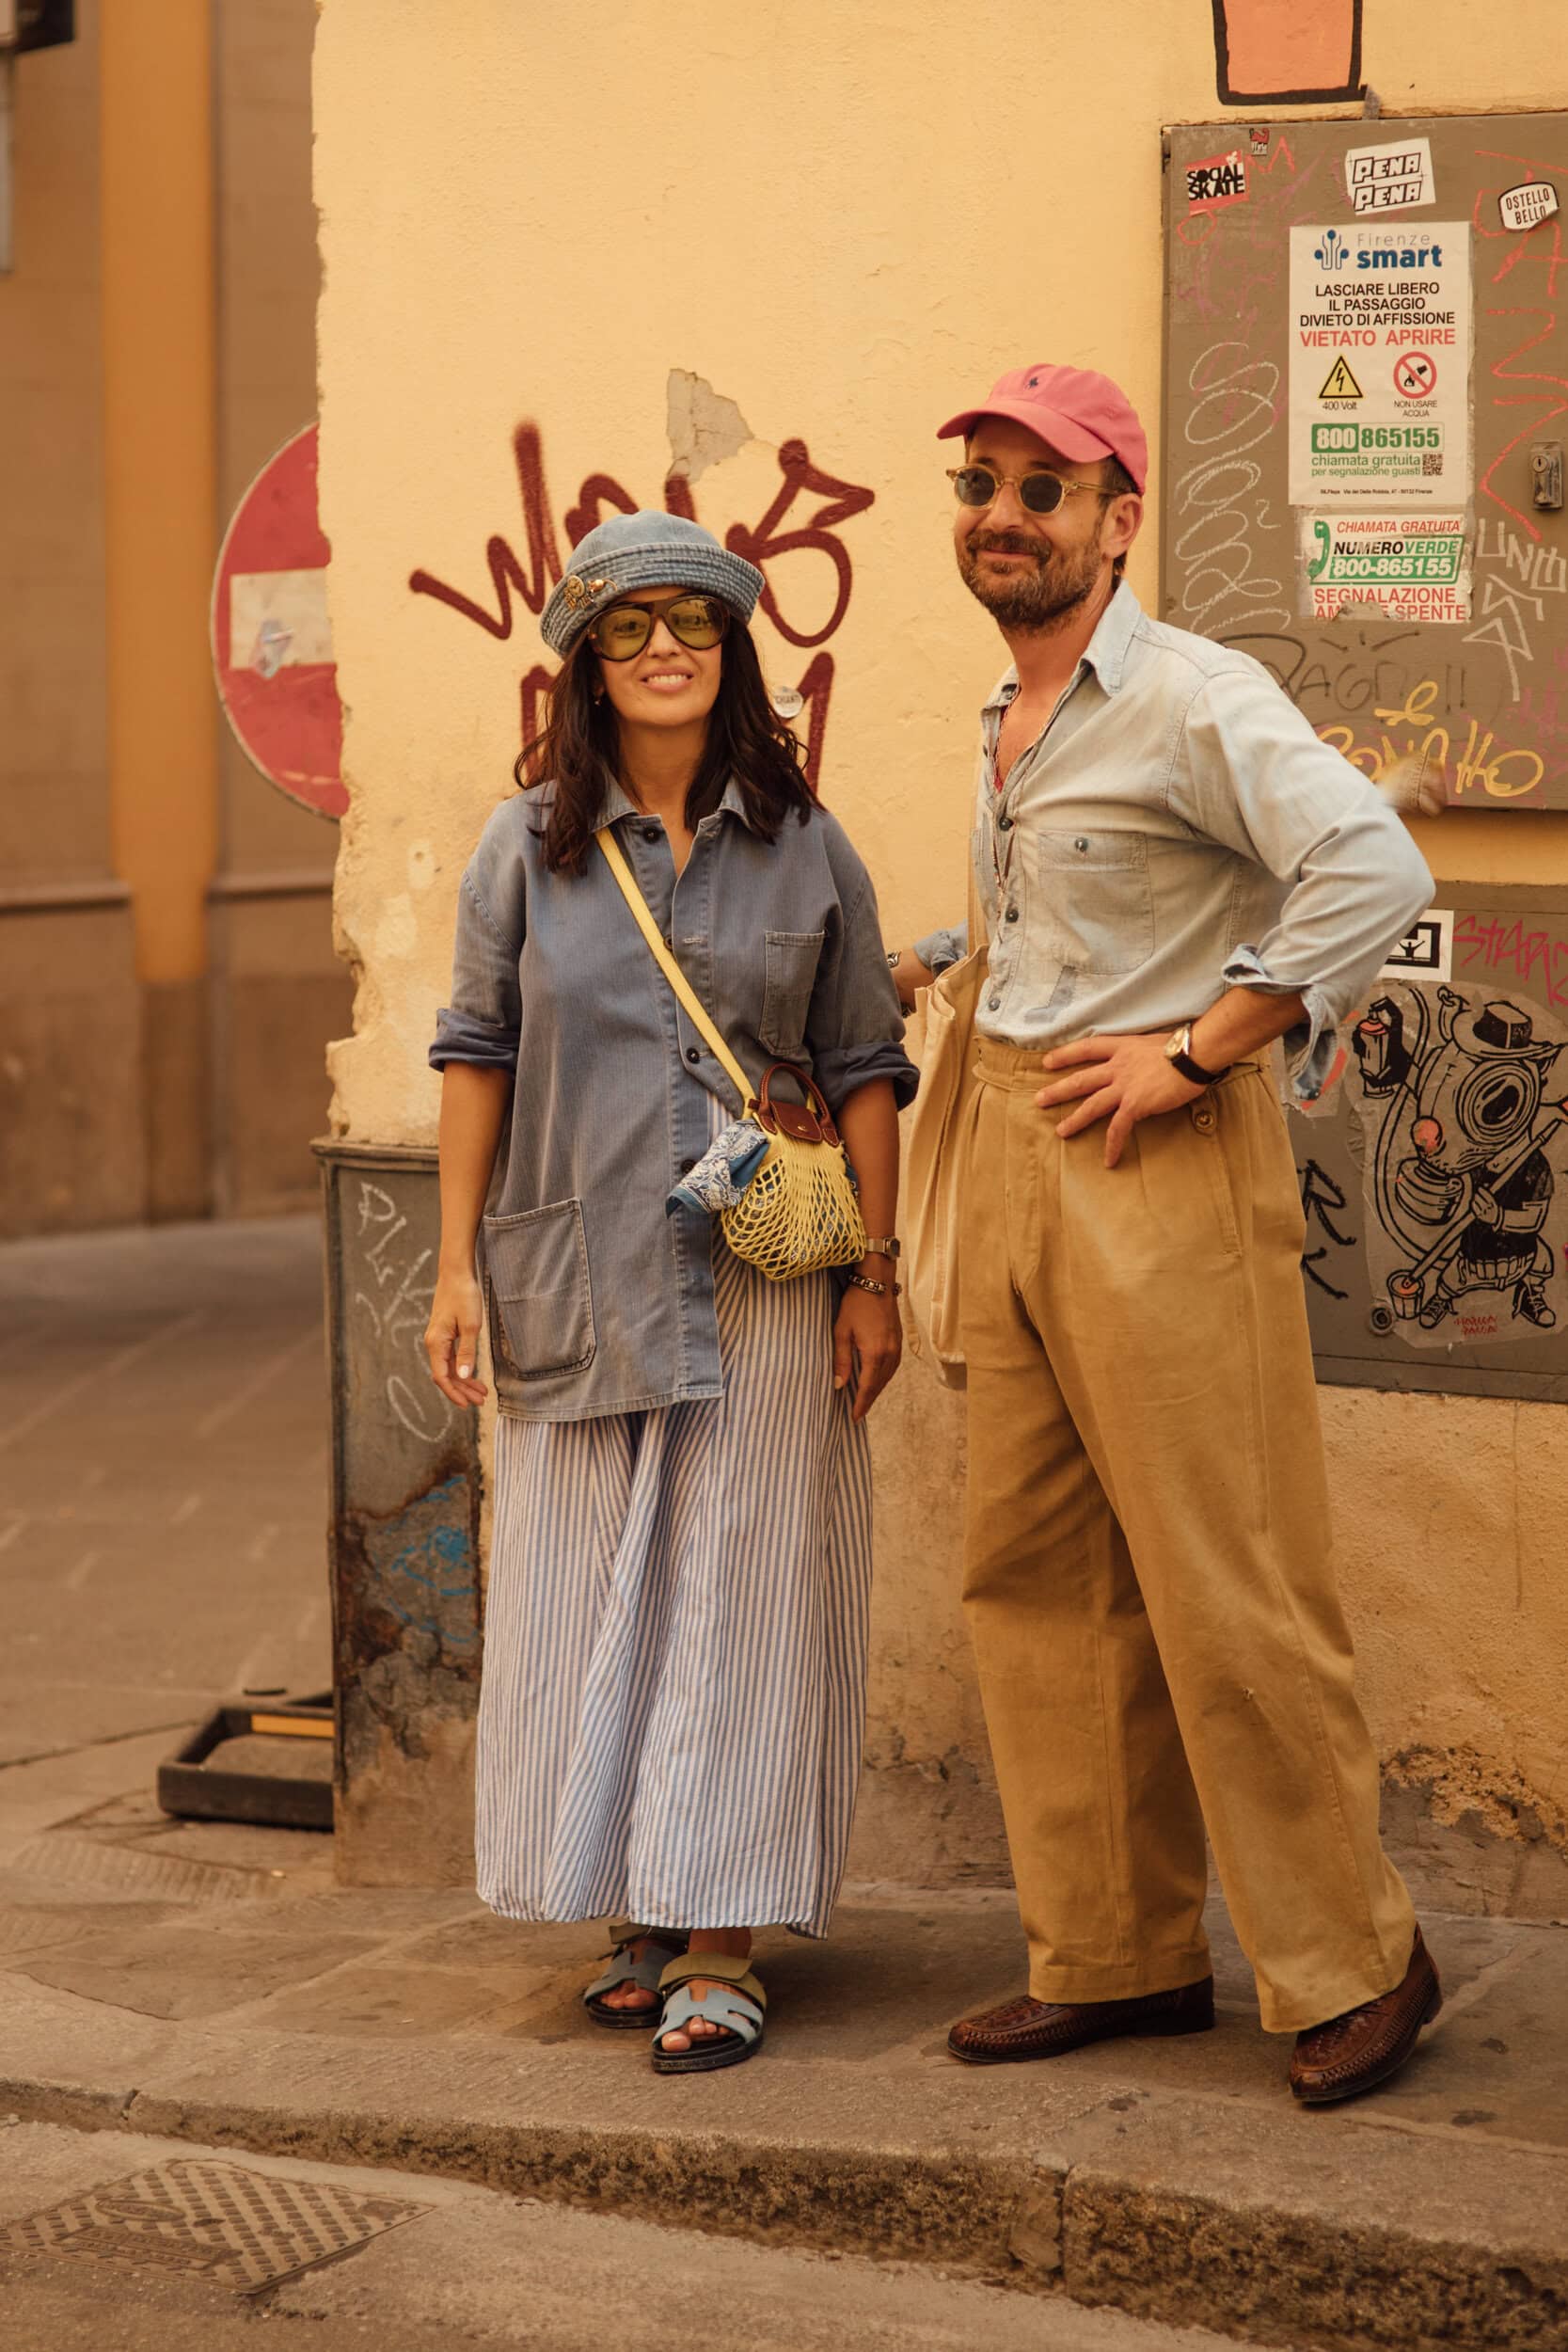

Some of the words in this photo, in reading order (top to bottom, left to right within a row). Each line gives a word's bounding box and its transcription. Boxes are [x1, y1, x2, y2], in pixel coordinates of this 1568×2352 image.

[1187, 164, 1243, 183] SOCIAL
[1353, 152, 1421, 184] PENA
[1188, 180, 1244, 200] SKATE
[1354, 181, 1422, 212] PENA
[1506, 187, 1550, 210] OSTELLO
[1514, 205, 1546, 225] BELLO
[1356, 233, 1431, 246] Firenze
[1356, 245, 1443, 269] smart
[1316, 283, 1385, 296] LASCIARE
[1388, 282, 1440, 295] LIBERO
[1329, 299, 1340, 311] IL
[1344, 297, 1426, 311] PASSAGGIO
[1300, 314, 1353, 326] DIVIETO
[1357, 313, 1370, 326] DI
[1373, 311, 1455, 326] AFFISSIONE
[1300, 330, 1376, 347] VIETATO
[1386, 328, 1456, 345] APRIRE
[1323, 402, 1339, 410] 400
[1340, 401, 1357, 410] Volt
[1316, 427, 1356, 450] 800
[1361, 427, 1440, 448] 865155
[1311, 454, 1369, 467] chiamata
[1372, 454, 1420, 469] gratuita
[1311, 468, 1325, 477] per
[1329, 467, 1390, 478] segnalazione
[1392, 467, 1420, 477] guasti
[1337, 521, 1397, 533] CHIAMATA
[1402, 520, 1460, 532] GRATUITA
[1332, 558, 1452, 576] 800-865155
[1314, 587, 1456, 603] SEGNALAZIONE
[1395, 605, 1466, 621] SPENTE
